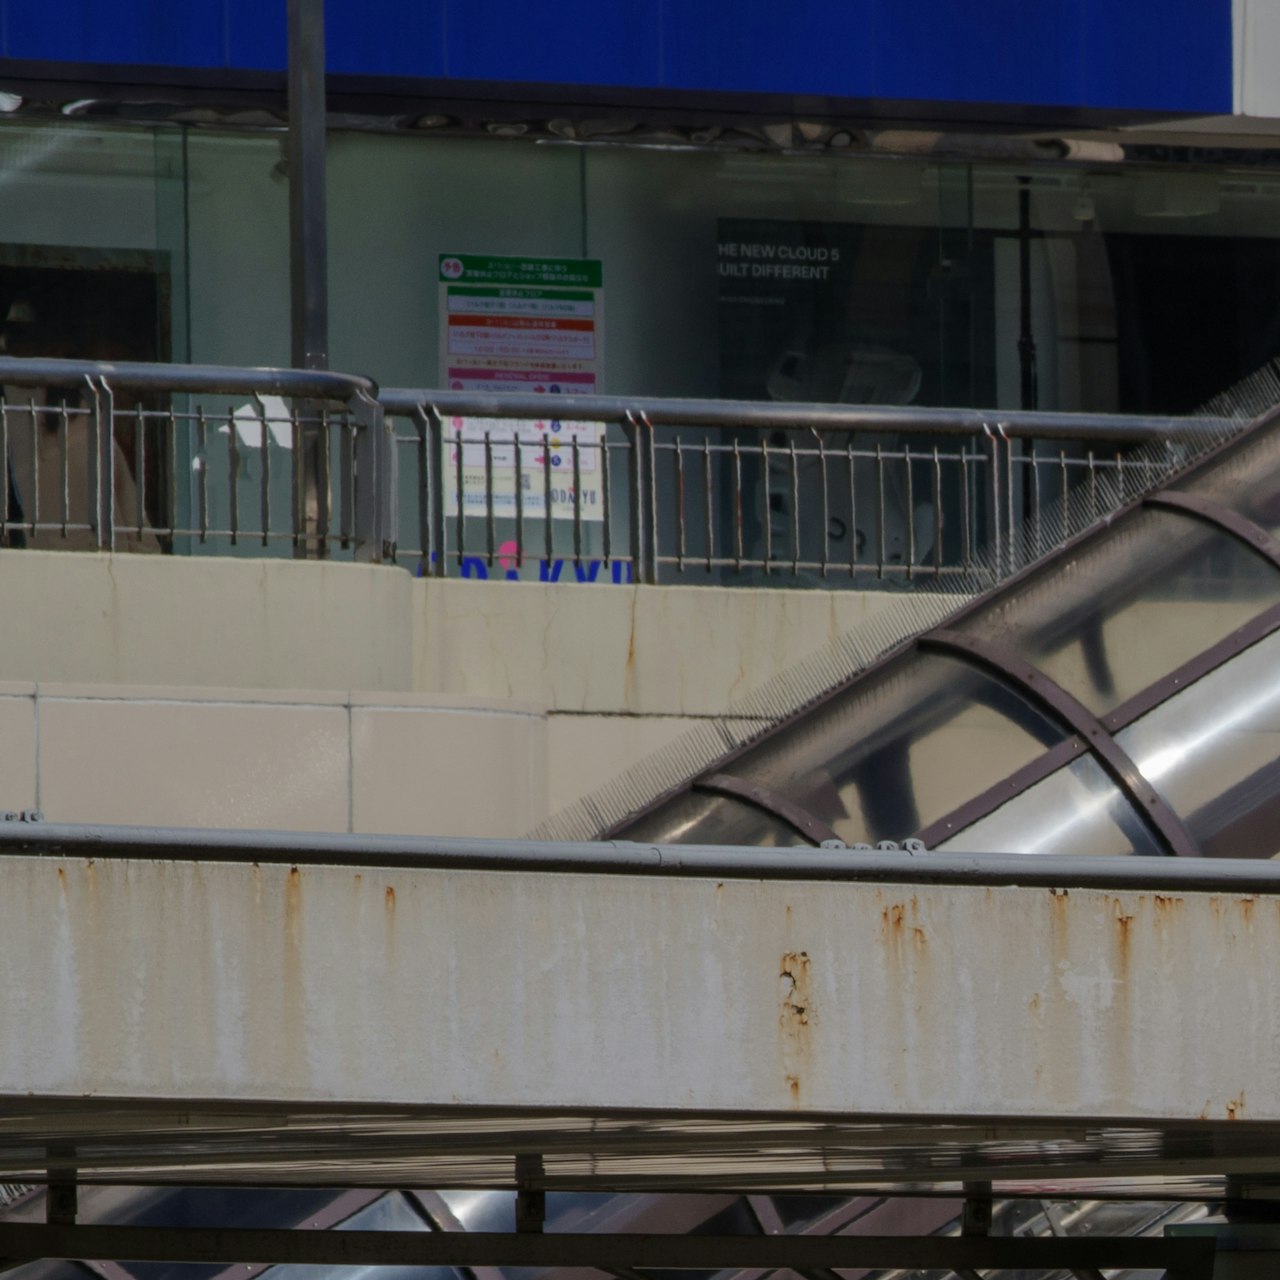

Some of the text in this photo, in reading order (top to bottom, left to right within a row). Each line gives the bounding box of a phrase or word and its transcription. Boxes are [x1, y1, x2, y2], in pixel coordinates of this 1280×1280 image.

[717, 243, 840, 261] HE NEW CLOUD 5
[717, 262, 831, 280] UILT DIFFERENT
[550, 487, 597, 505] ODAYU
